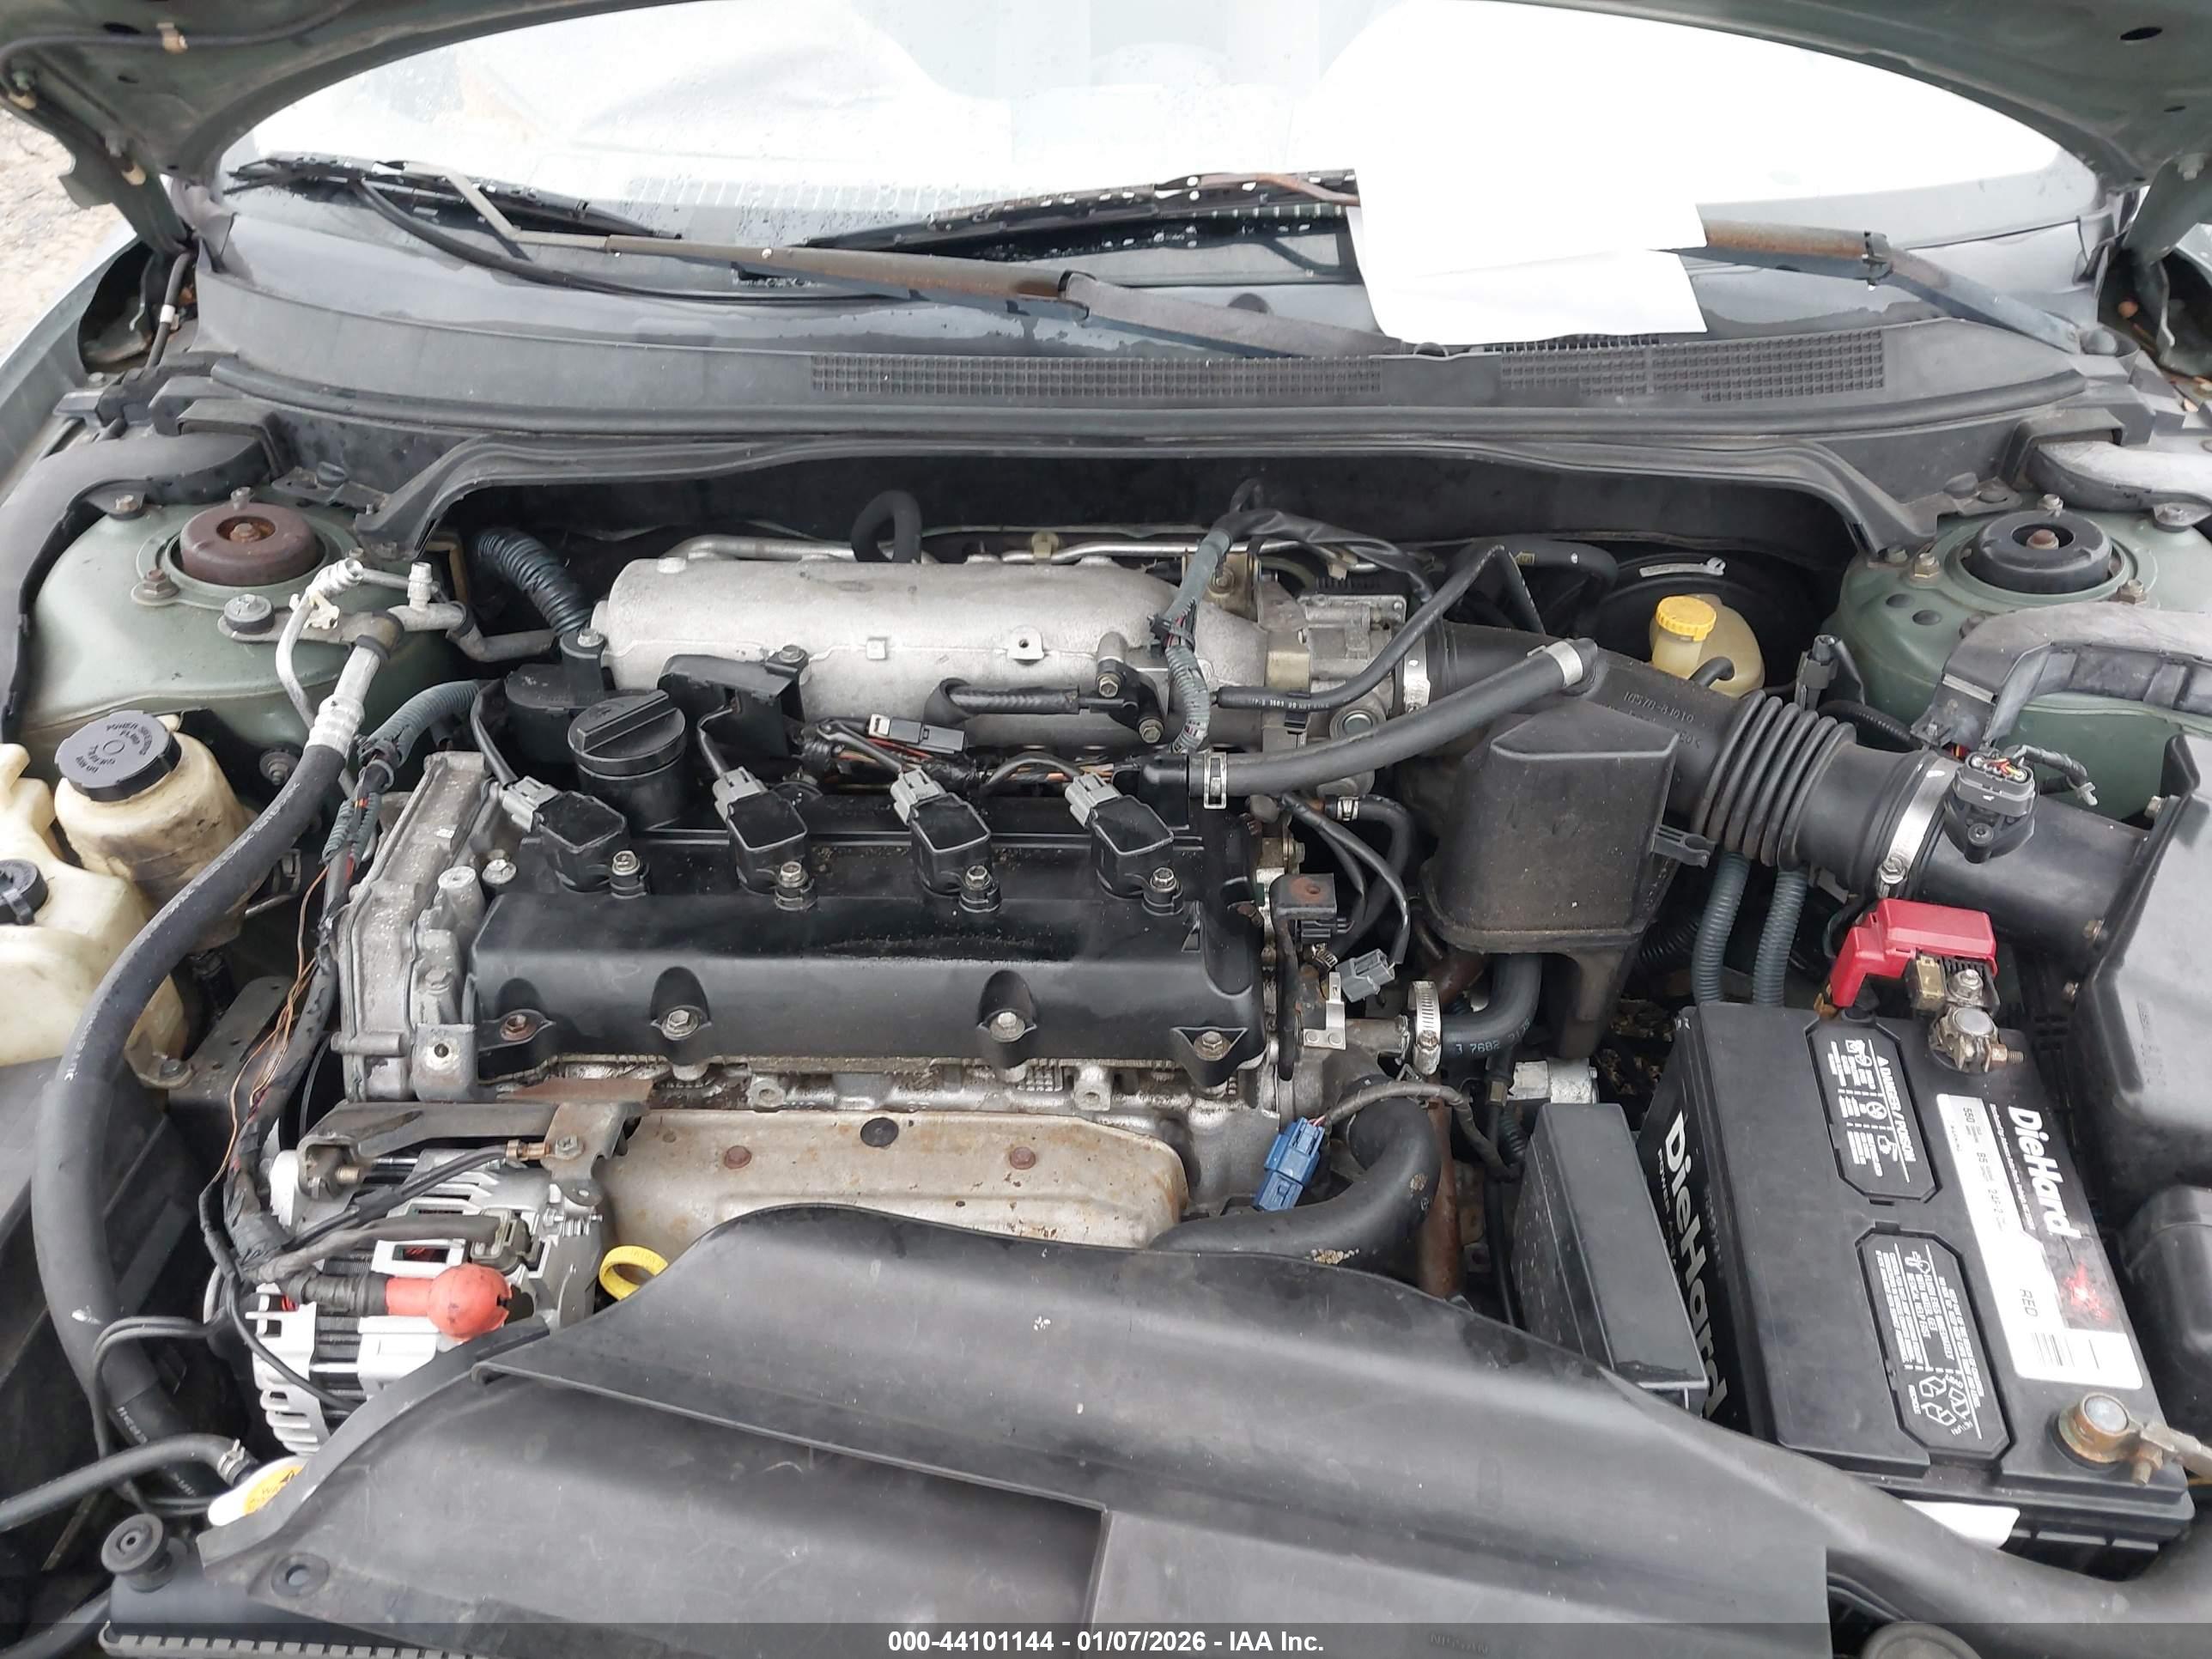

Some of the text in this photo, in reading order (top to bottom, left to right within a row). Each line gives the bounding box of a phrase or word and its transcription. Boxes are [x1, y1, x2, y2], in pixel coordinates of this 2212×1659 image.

[1657, 1148, 1670, 1213] POWER
[2008, 1105, 2082, 1239] DieHard
[1665, 1109, 1728, 1418] DieHard
[2020, 1288, 2039, 1317] RED
